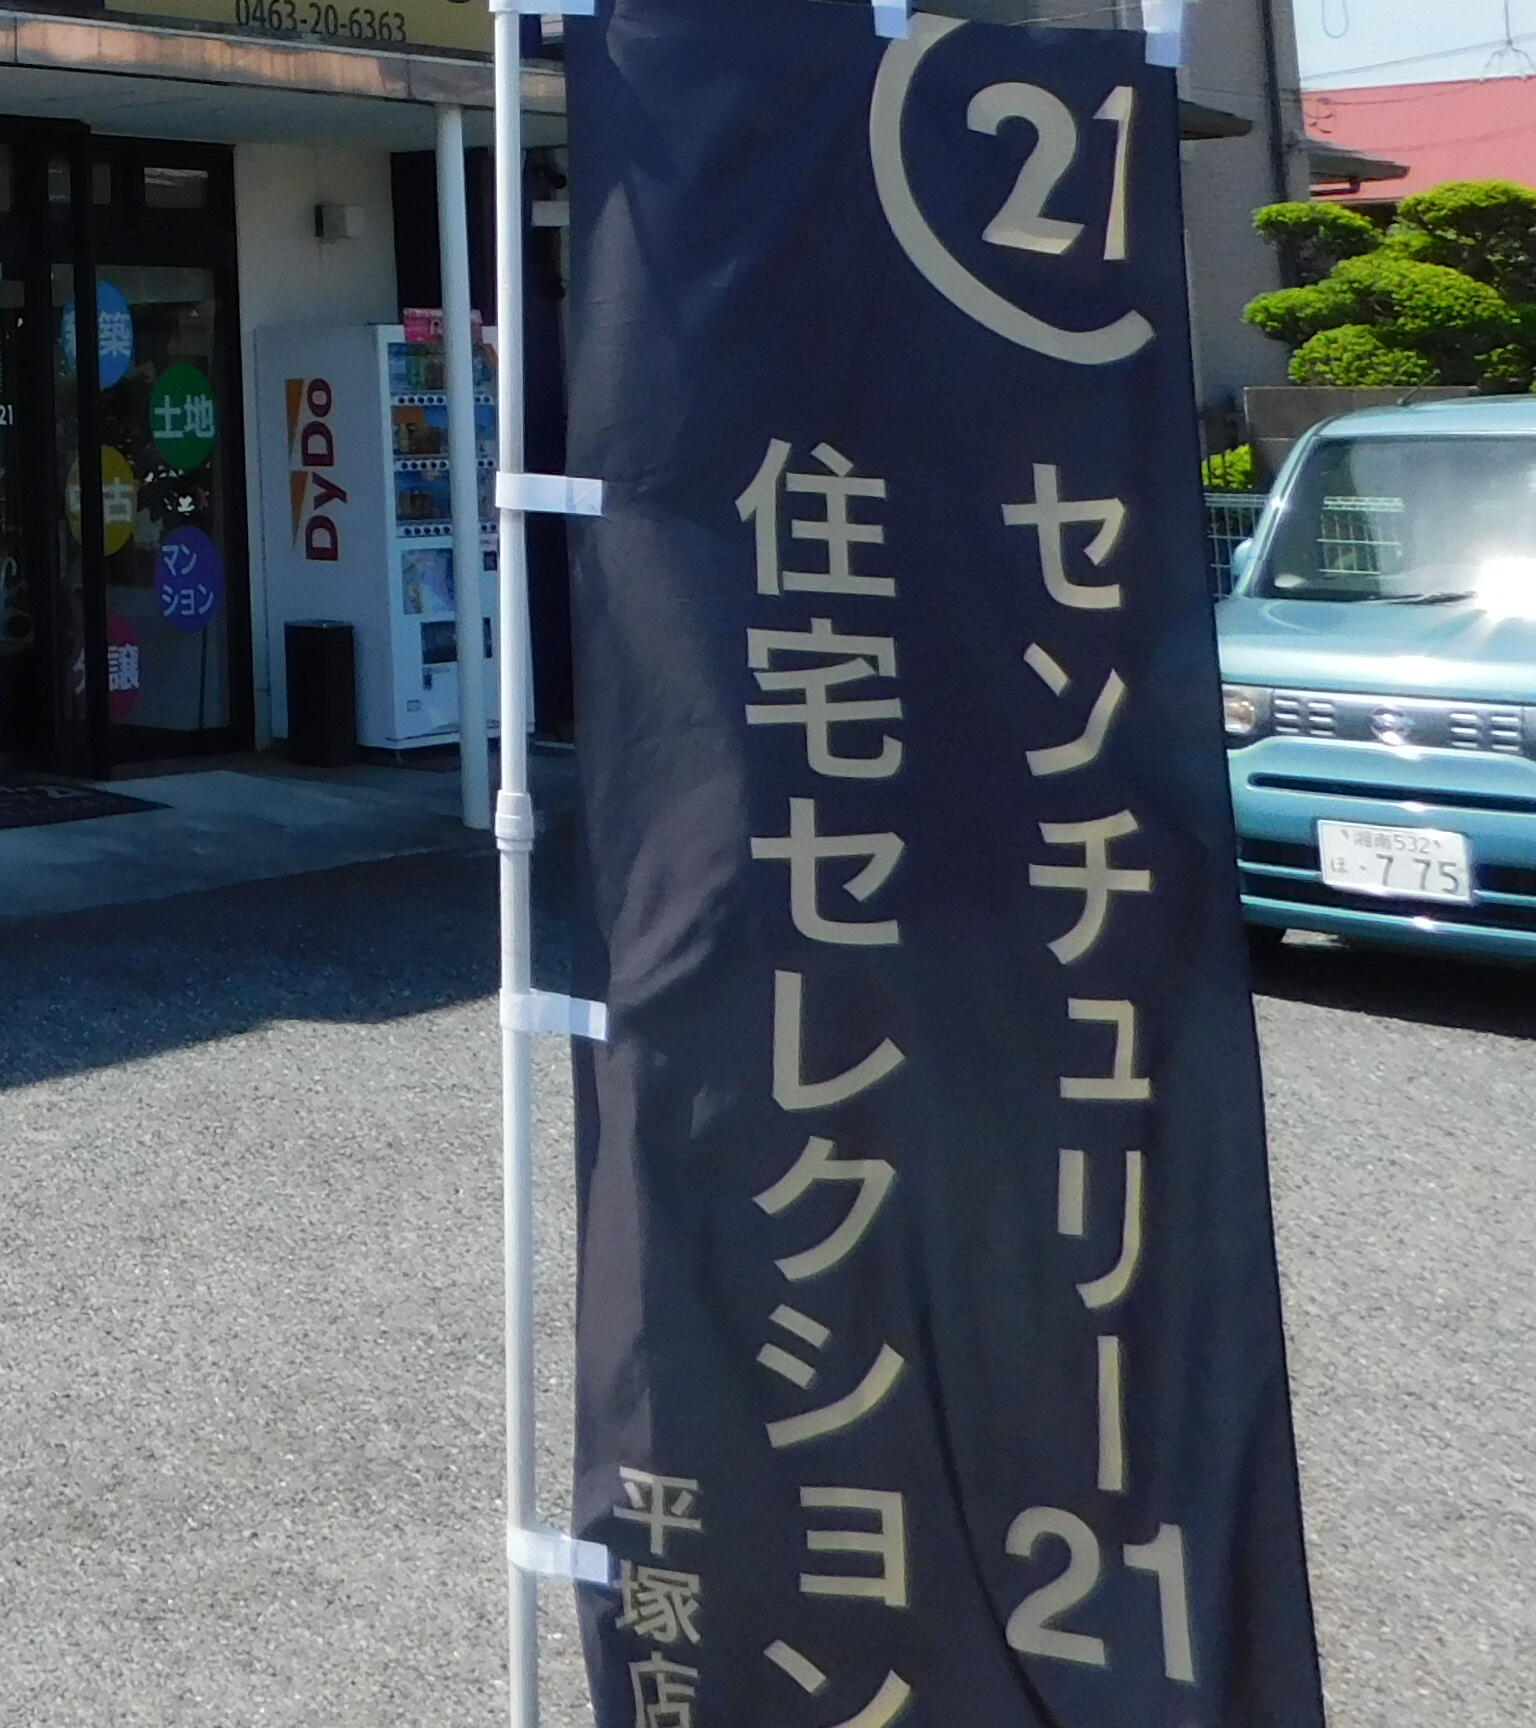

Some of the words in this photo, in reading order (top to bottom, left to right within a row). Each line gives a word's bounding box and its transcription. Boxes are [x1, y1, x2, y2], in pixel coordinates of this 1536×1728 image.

[153, 393, 216, 439] 土地
[735, 438, 912, 1728] 住宅セレクション
[612, 1464, 703, 1728] 平塚店
